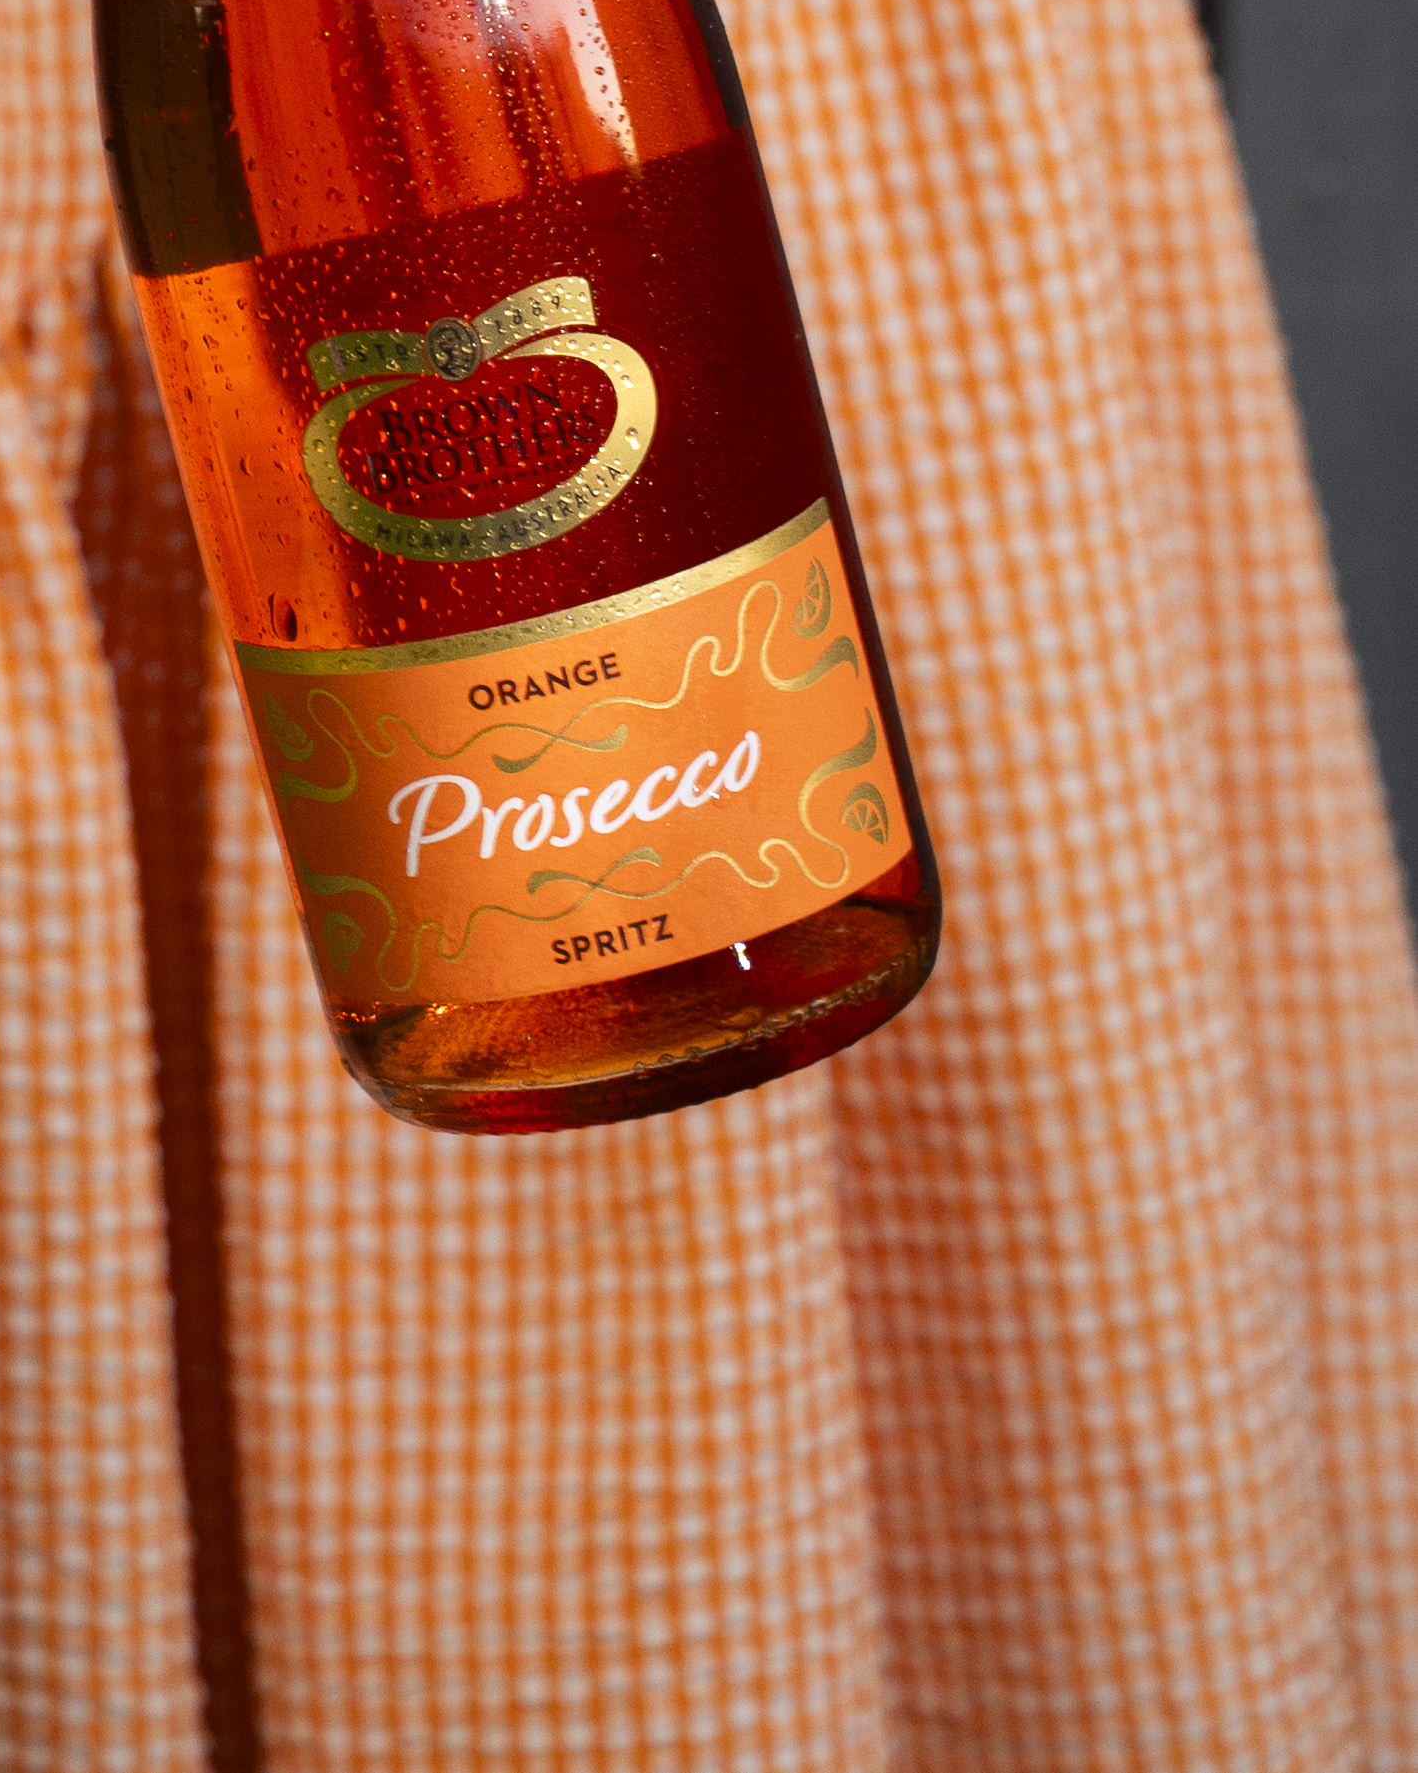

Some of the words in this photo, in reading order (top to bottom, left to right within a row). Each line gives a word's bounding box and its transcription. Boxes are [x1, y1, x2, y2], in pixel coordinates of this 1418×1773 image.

[367, 405, 599, 493] BROTHERS
[380, 377, 560, 450] BROWN
[469, 653, 621, 711] ORANGE
[388, 731, 761, 876] Prosecco
[551, 914, 674, 965] SPRITZ
